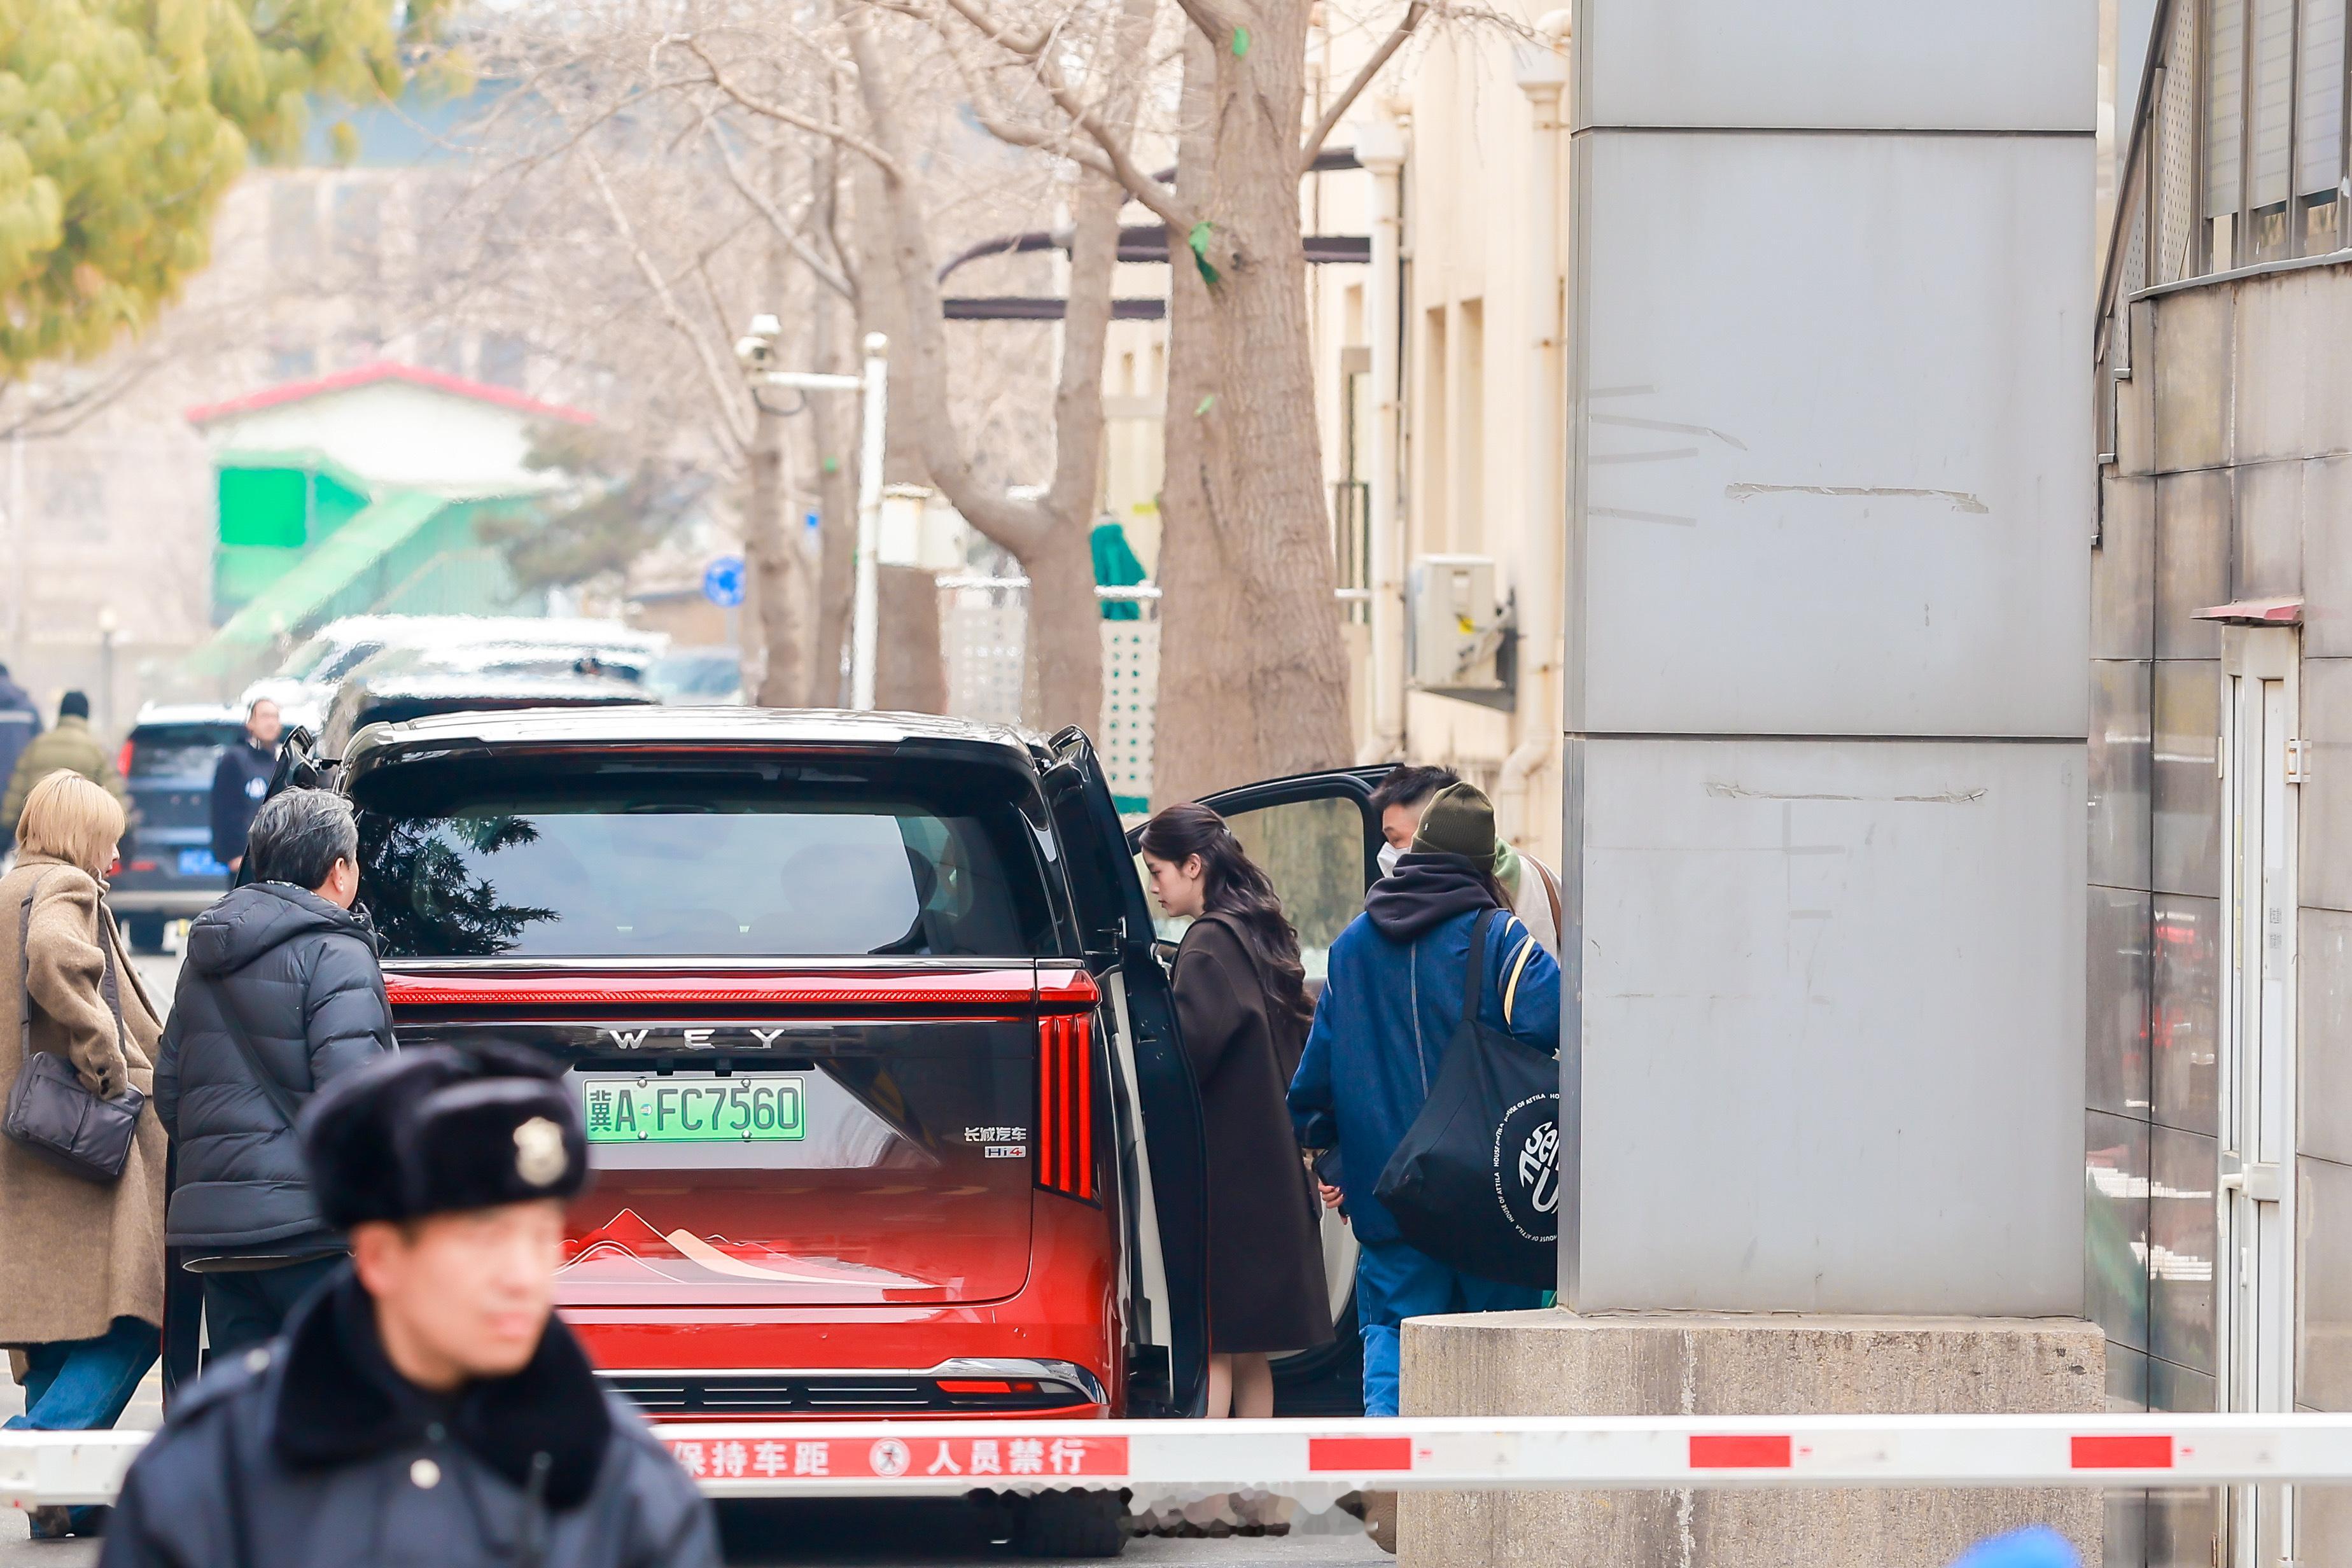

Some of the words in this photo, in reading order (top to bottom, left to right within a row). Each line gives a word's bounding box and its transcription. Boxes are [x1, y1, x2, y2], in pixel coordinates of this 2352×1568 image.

[609, 1029, 785, 1049] WEY
[1504, 1105, 1518, 1122] HOUSE
[1525, 1093, 1546, 1105] ATTILA
[964, 1126, 1026, 1142] 长城汽车
[988, 1147, 1022, 1156] Hi4
[1494, 1172, 1502, 1194] ATTILA
[1501, 1204, 1515, 1222] HOUSE
[1515, 1224, 1532, 1239] ATTILA
[673, 1441, 830, 1477] 保持车距
[927, 1438, 1086, 1475] 人员禁行
